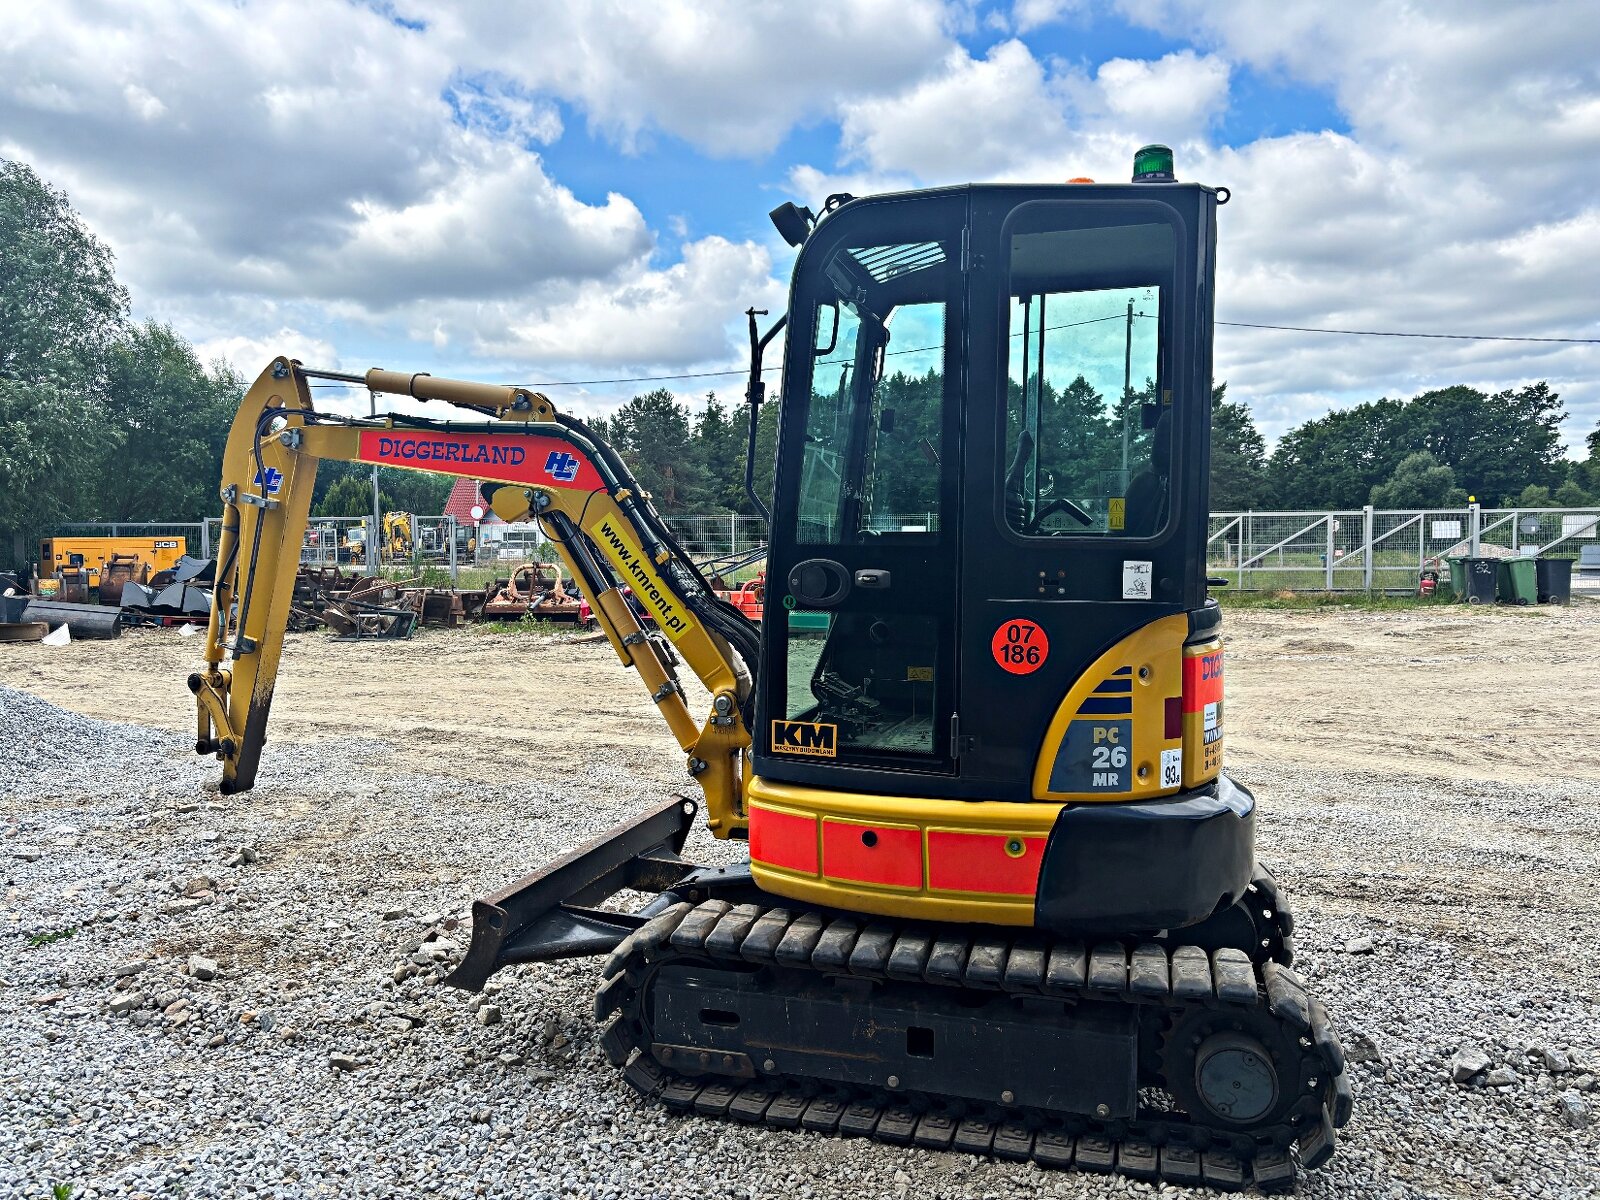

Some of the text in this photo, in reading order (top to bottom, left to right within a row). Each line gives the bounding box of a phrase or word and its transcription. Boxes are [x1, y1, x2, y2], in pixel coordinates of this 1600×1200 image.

[378, 438, 526, 465] DIGGERLAND
[601, 521, 687, 633] www.kmrent.pl
[1007, 624, 1036, 643] 07
[1000, 644, 1040, 665] 186
[775, 722, 834, 749] KM
[1093, 727, 1119, 744] PC
[1092, 746, 1127, 768] 26
[1092, 773, 1119, 787] MR
[1165, 765, 1176, 785] 93
